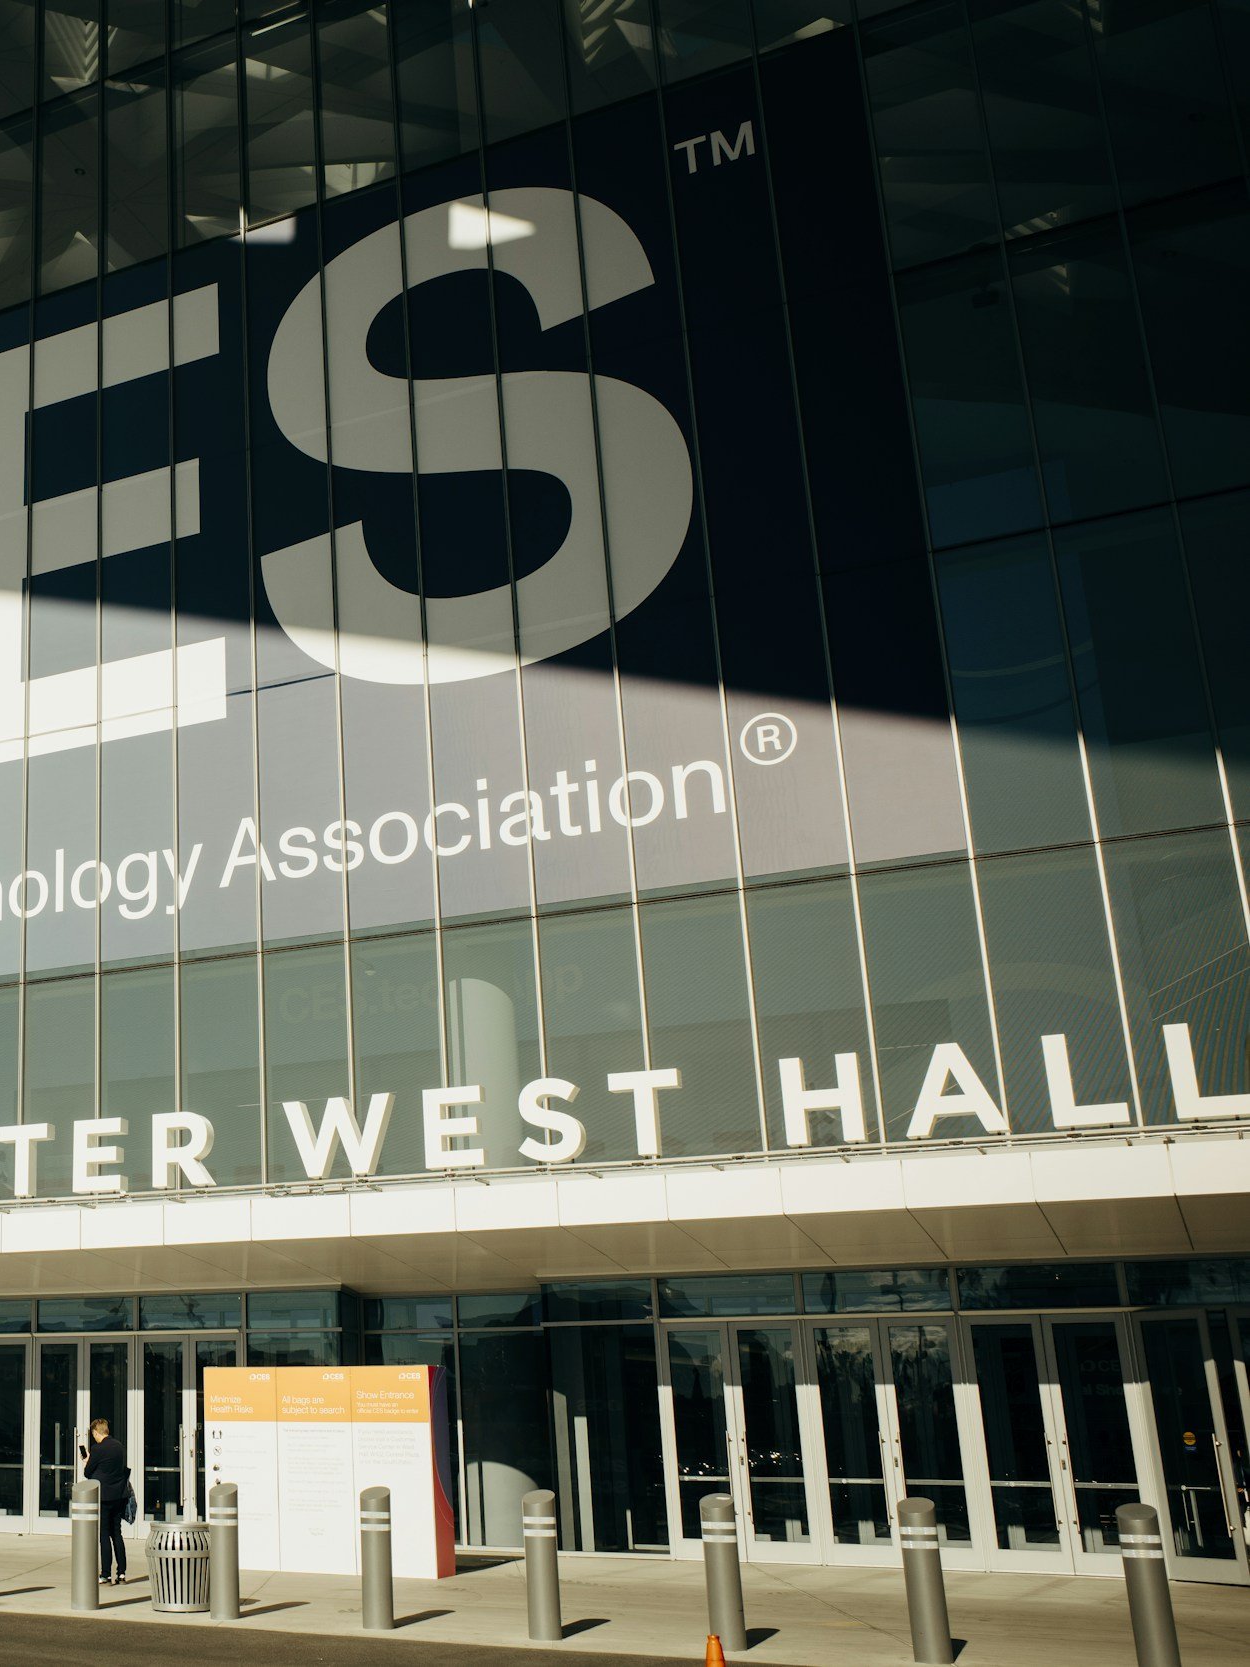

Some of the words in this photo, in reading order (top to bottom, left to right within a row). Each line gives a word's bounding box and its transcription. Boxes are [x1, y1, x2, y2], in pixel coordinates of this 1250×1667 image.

[282, 1067, 682, 1180] WEST
[779, 1022, 1250, 1148] HALL
[256, 1373, 271, 1381] CES
[406, 1372, 421, 1380] CES
[356, 1390, 378, 1399] Show
[380, 1390, 414, 1399] Entrance
[210, 1395, 242, 1404] Minimize
[282, 1395, 291, 1404] All
[292, 1396, 311, 1406] bags
[210, 1405, 233, 1414] Health
[234, 1405, 254, 1414] Risks
[282, 1405, 309, 1416] subject
[310, 1406, 318, 1414] to
[319, 1405, 345, 1415] search
